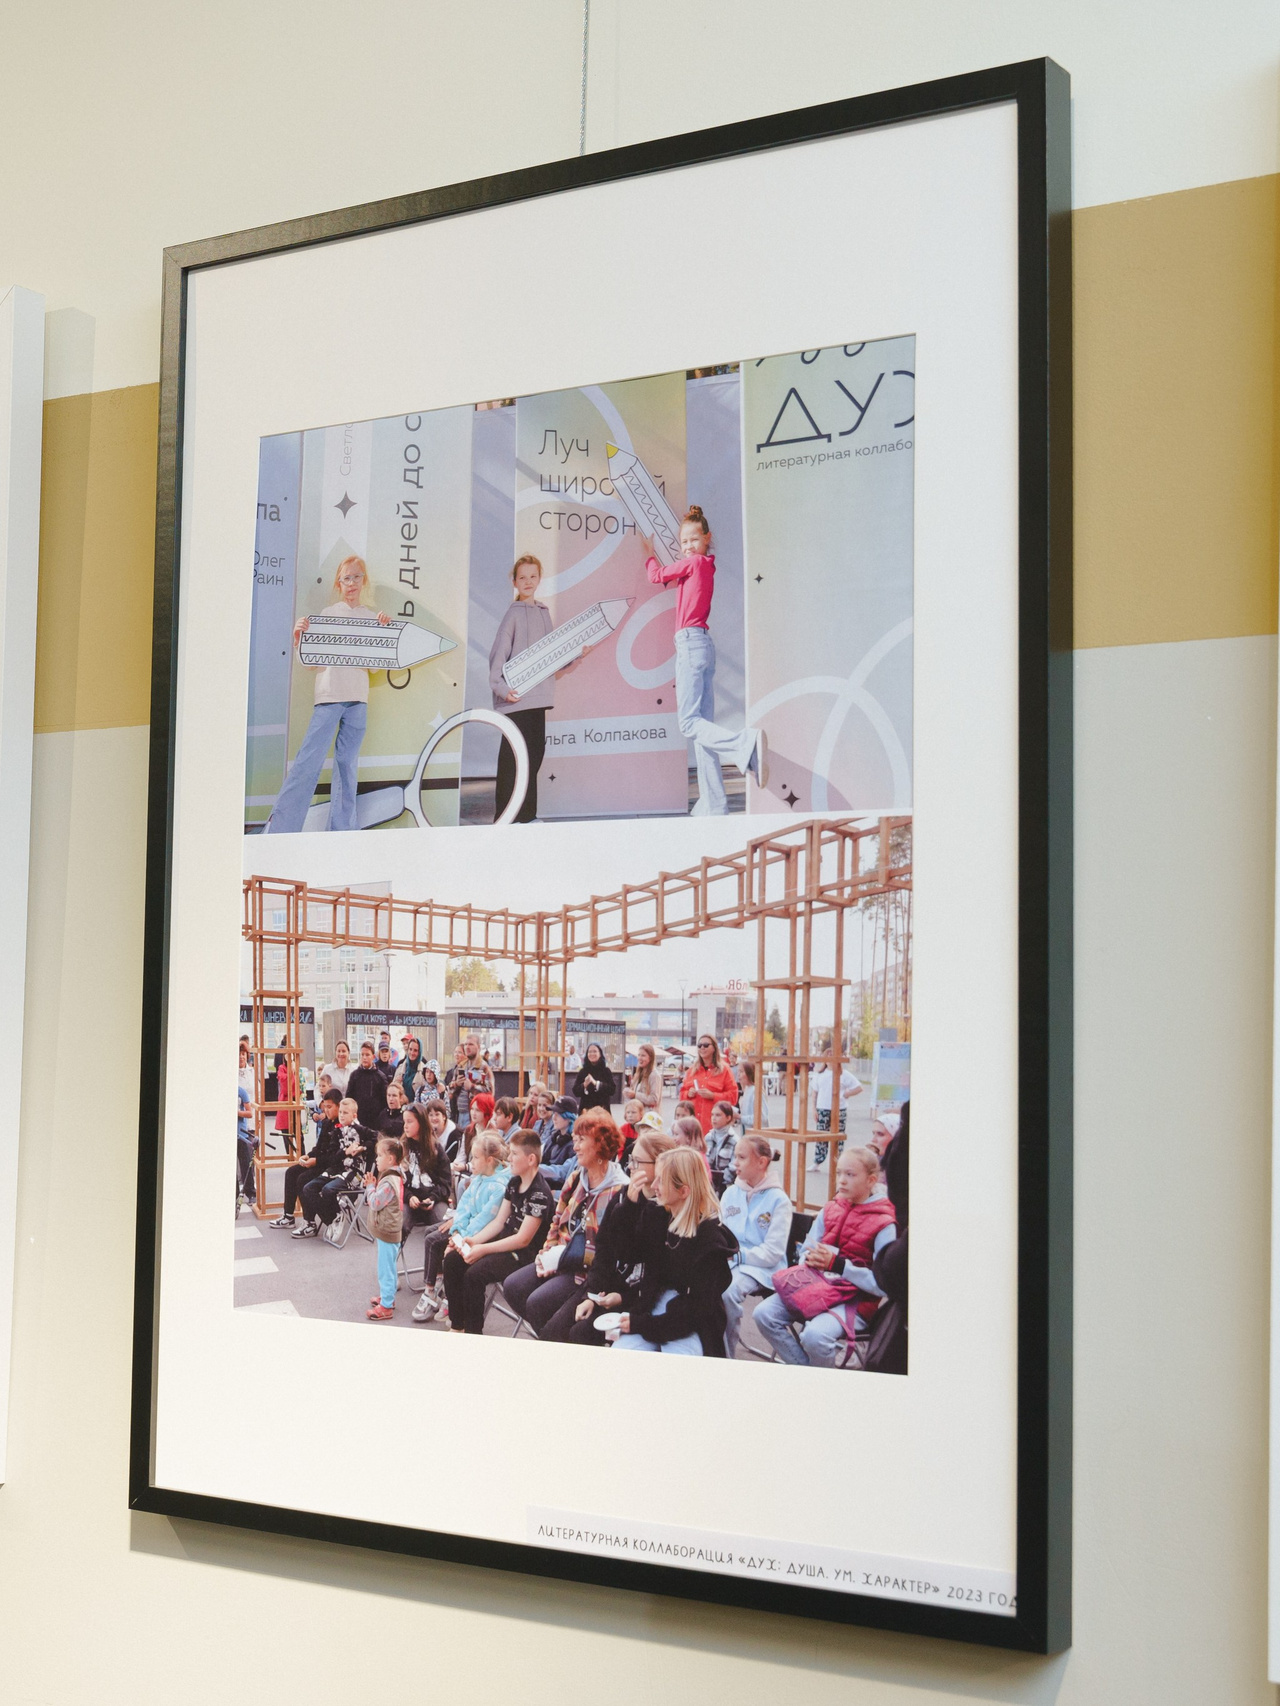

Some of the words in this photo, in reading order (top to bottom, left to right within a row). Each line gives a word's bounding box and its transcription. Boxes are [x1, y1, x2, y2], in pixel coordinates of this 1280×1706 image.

[403, 443, 424, 489] до
[538, 429, 589, 464] Луч
[756, 449, 851, 471] литературная
[855, 439, 913, 457] коллабо
[396, 500, 421, 590] дней
[545, 733, 576, 746] льга
[584, 727, 667, 743] Колпакова
[538, 1525, 629, 1548] ЛИТЕРАТУРНАЯ
[633, 1538, 733, 1564] КОЛЛАБОРАЦИЯ
[738, 1555, 782, 1571] «ДУХ:
[786, 1562, 828, 1579] ДУША.
[834, 1569, 856, 1583] УМ.
[862, 1572, 940, 1595] ХАРАКТЕР»
[947, 1586, 982, 1602] 2023
